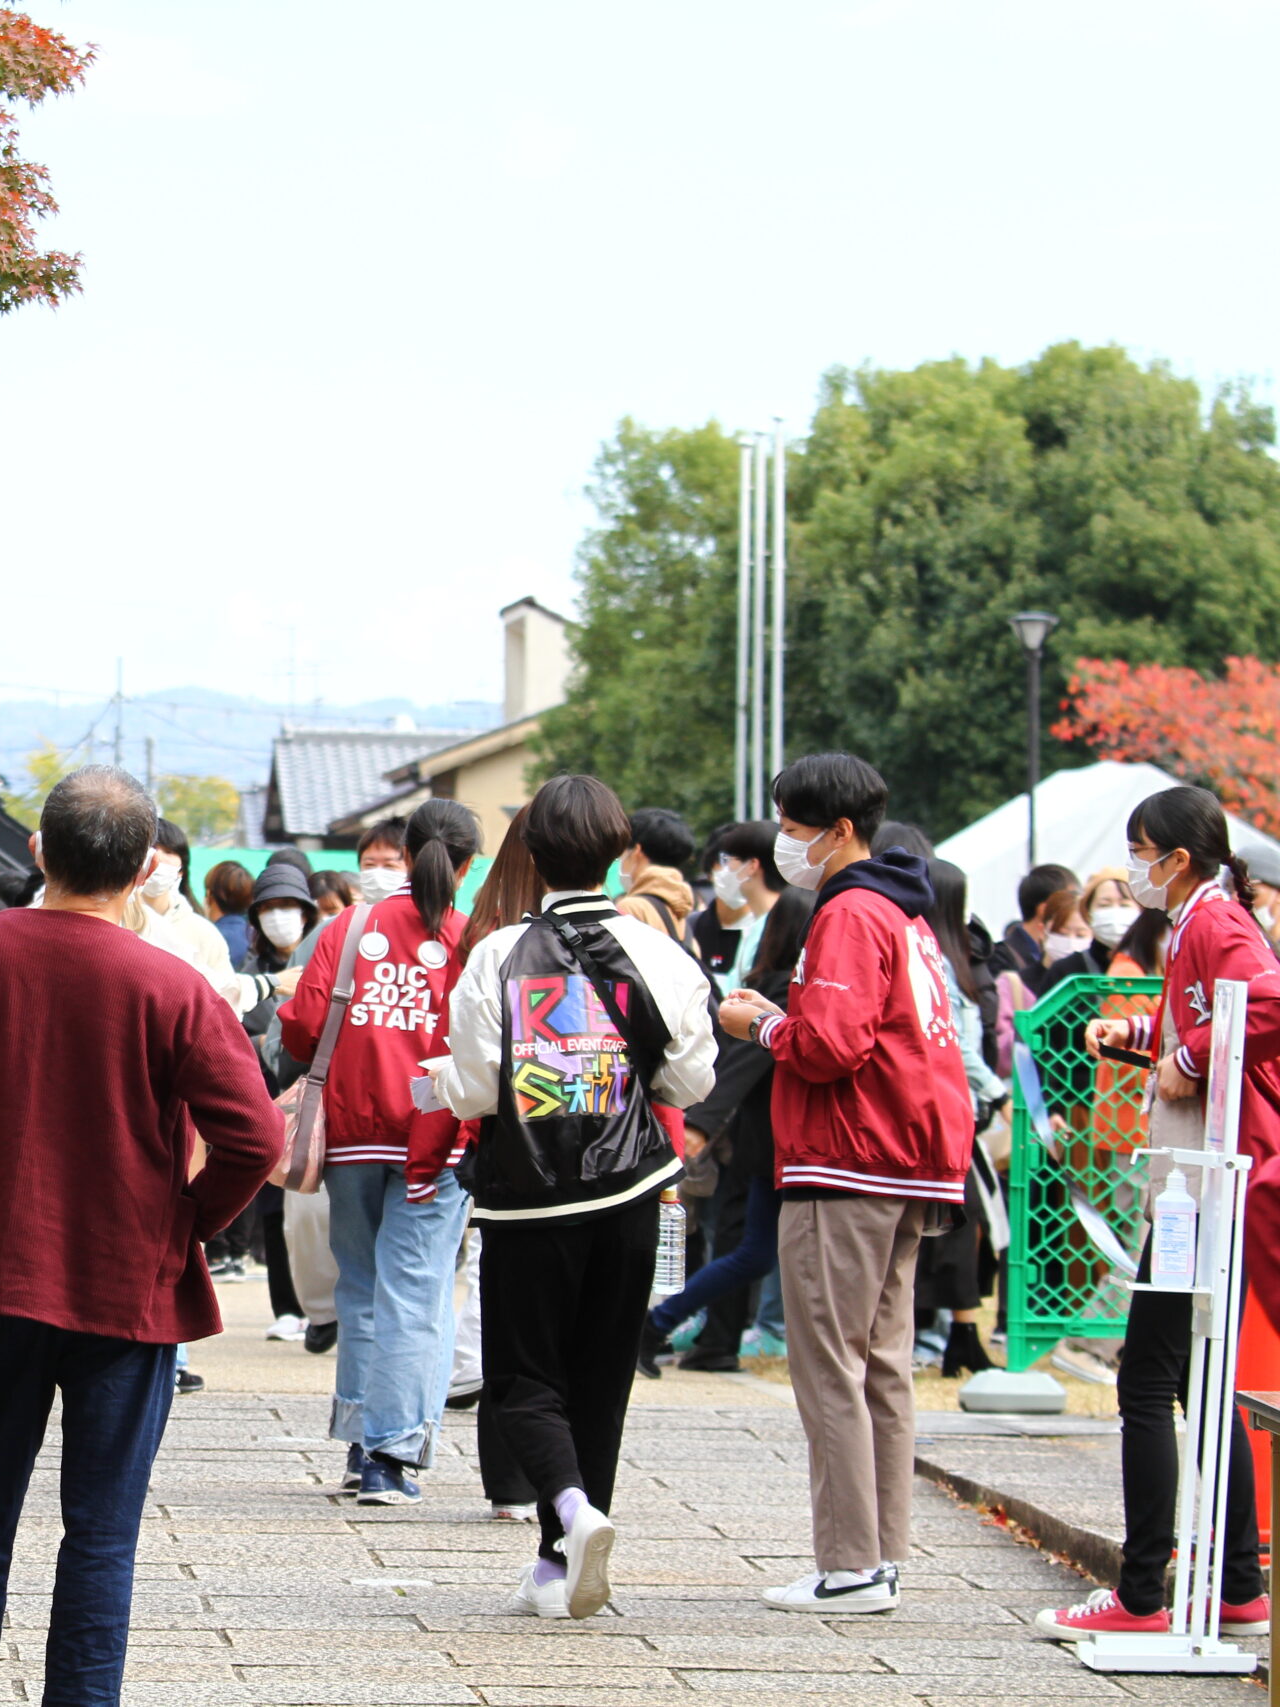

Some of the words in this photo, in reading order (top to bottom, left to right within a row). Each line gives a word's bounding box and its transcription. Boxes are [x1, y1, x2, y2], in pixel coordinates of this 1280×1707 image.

[374, 962, 428, 988] OIC
[362, 981, 431, 1011] 2021
[351, 1003, 440, 1035] STAFF
[512, 1040, 566, 1056] OFFICIAL
[567, 1038, 601, 1052] EVENT
[601, 1039, 628, 1053] STAFF
